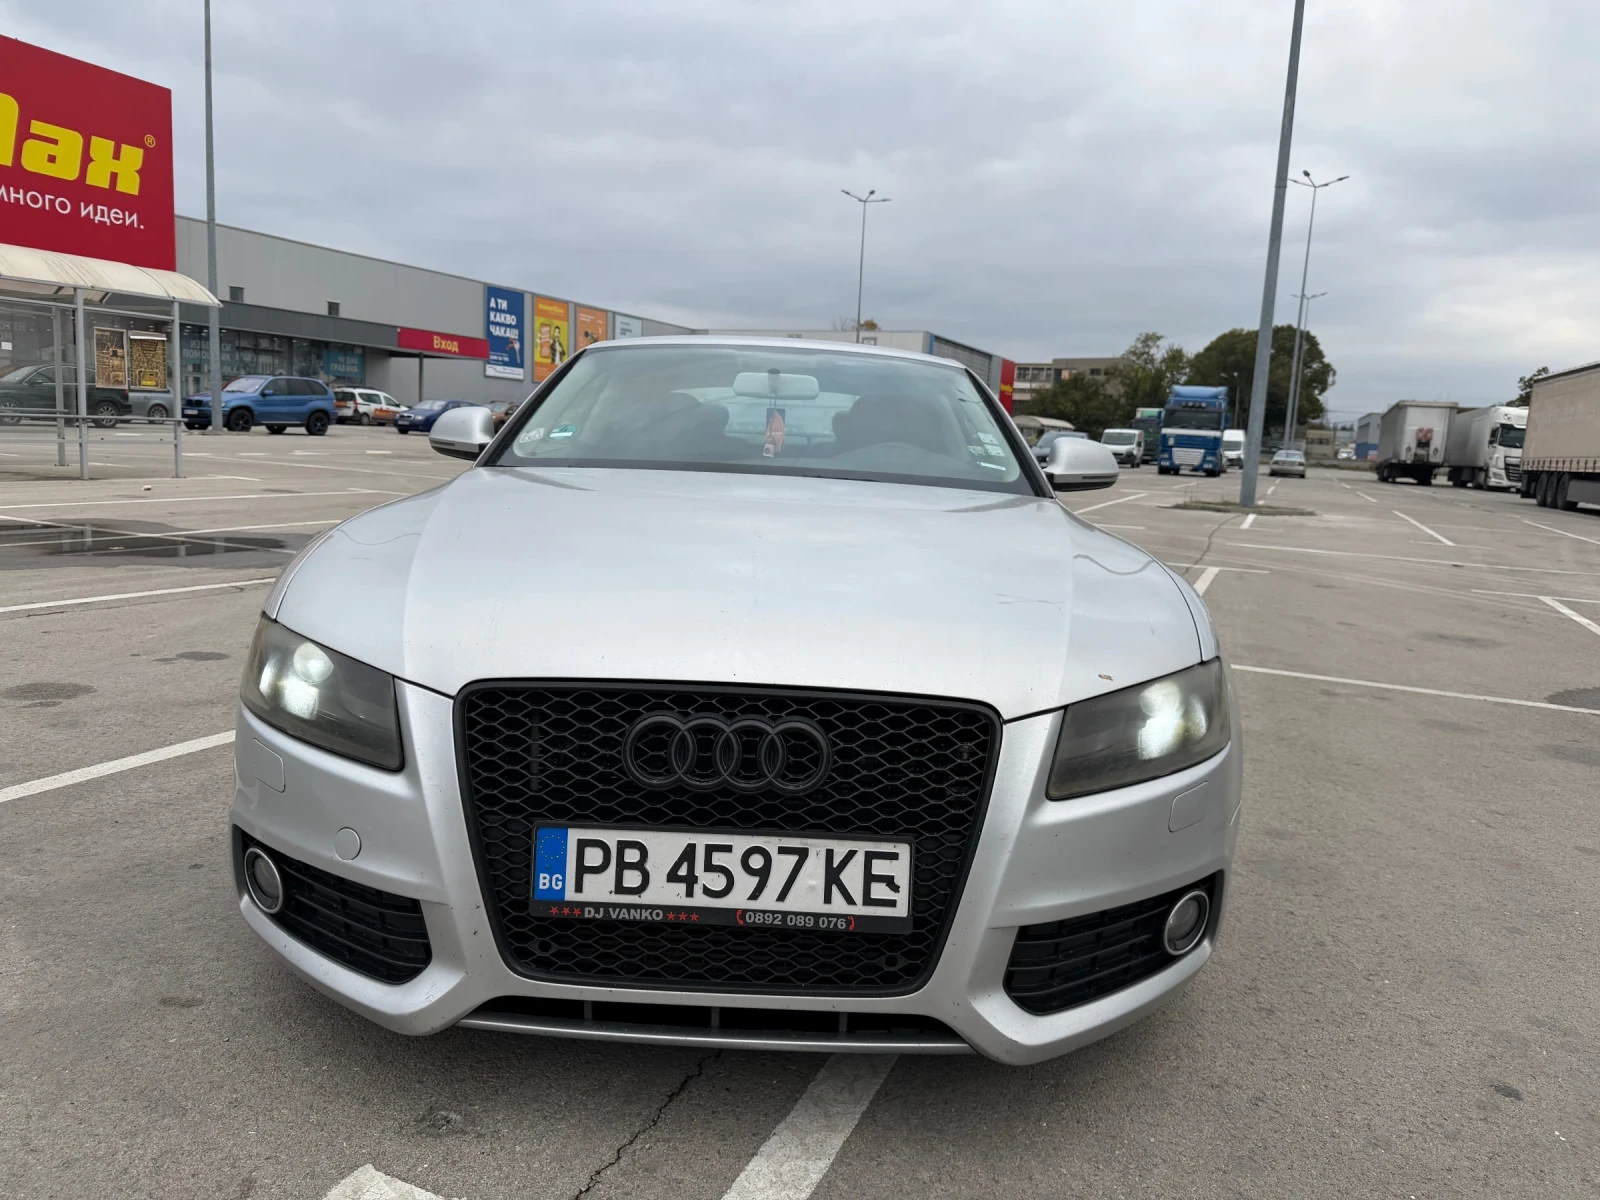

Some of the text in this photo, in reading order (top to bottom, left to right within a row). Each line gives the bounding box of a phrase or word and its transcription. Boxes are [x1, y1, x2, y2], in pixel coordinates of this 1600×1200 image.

[80, 201, 144, 230] идеи.
[490, 297, 508, 311] А ТИ
[490, 311, 517, 326] КАКВО
[433, 335, 459, 353] Вход
[538, 873, 563, 890] BG
[574, 838, 900, 908] PB 4597 KE
[584, 907, 847, 930] DJ VANKO 0892 089 076
